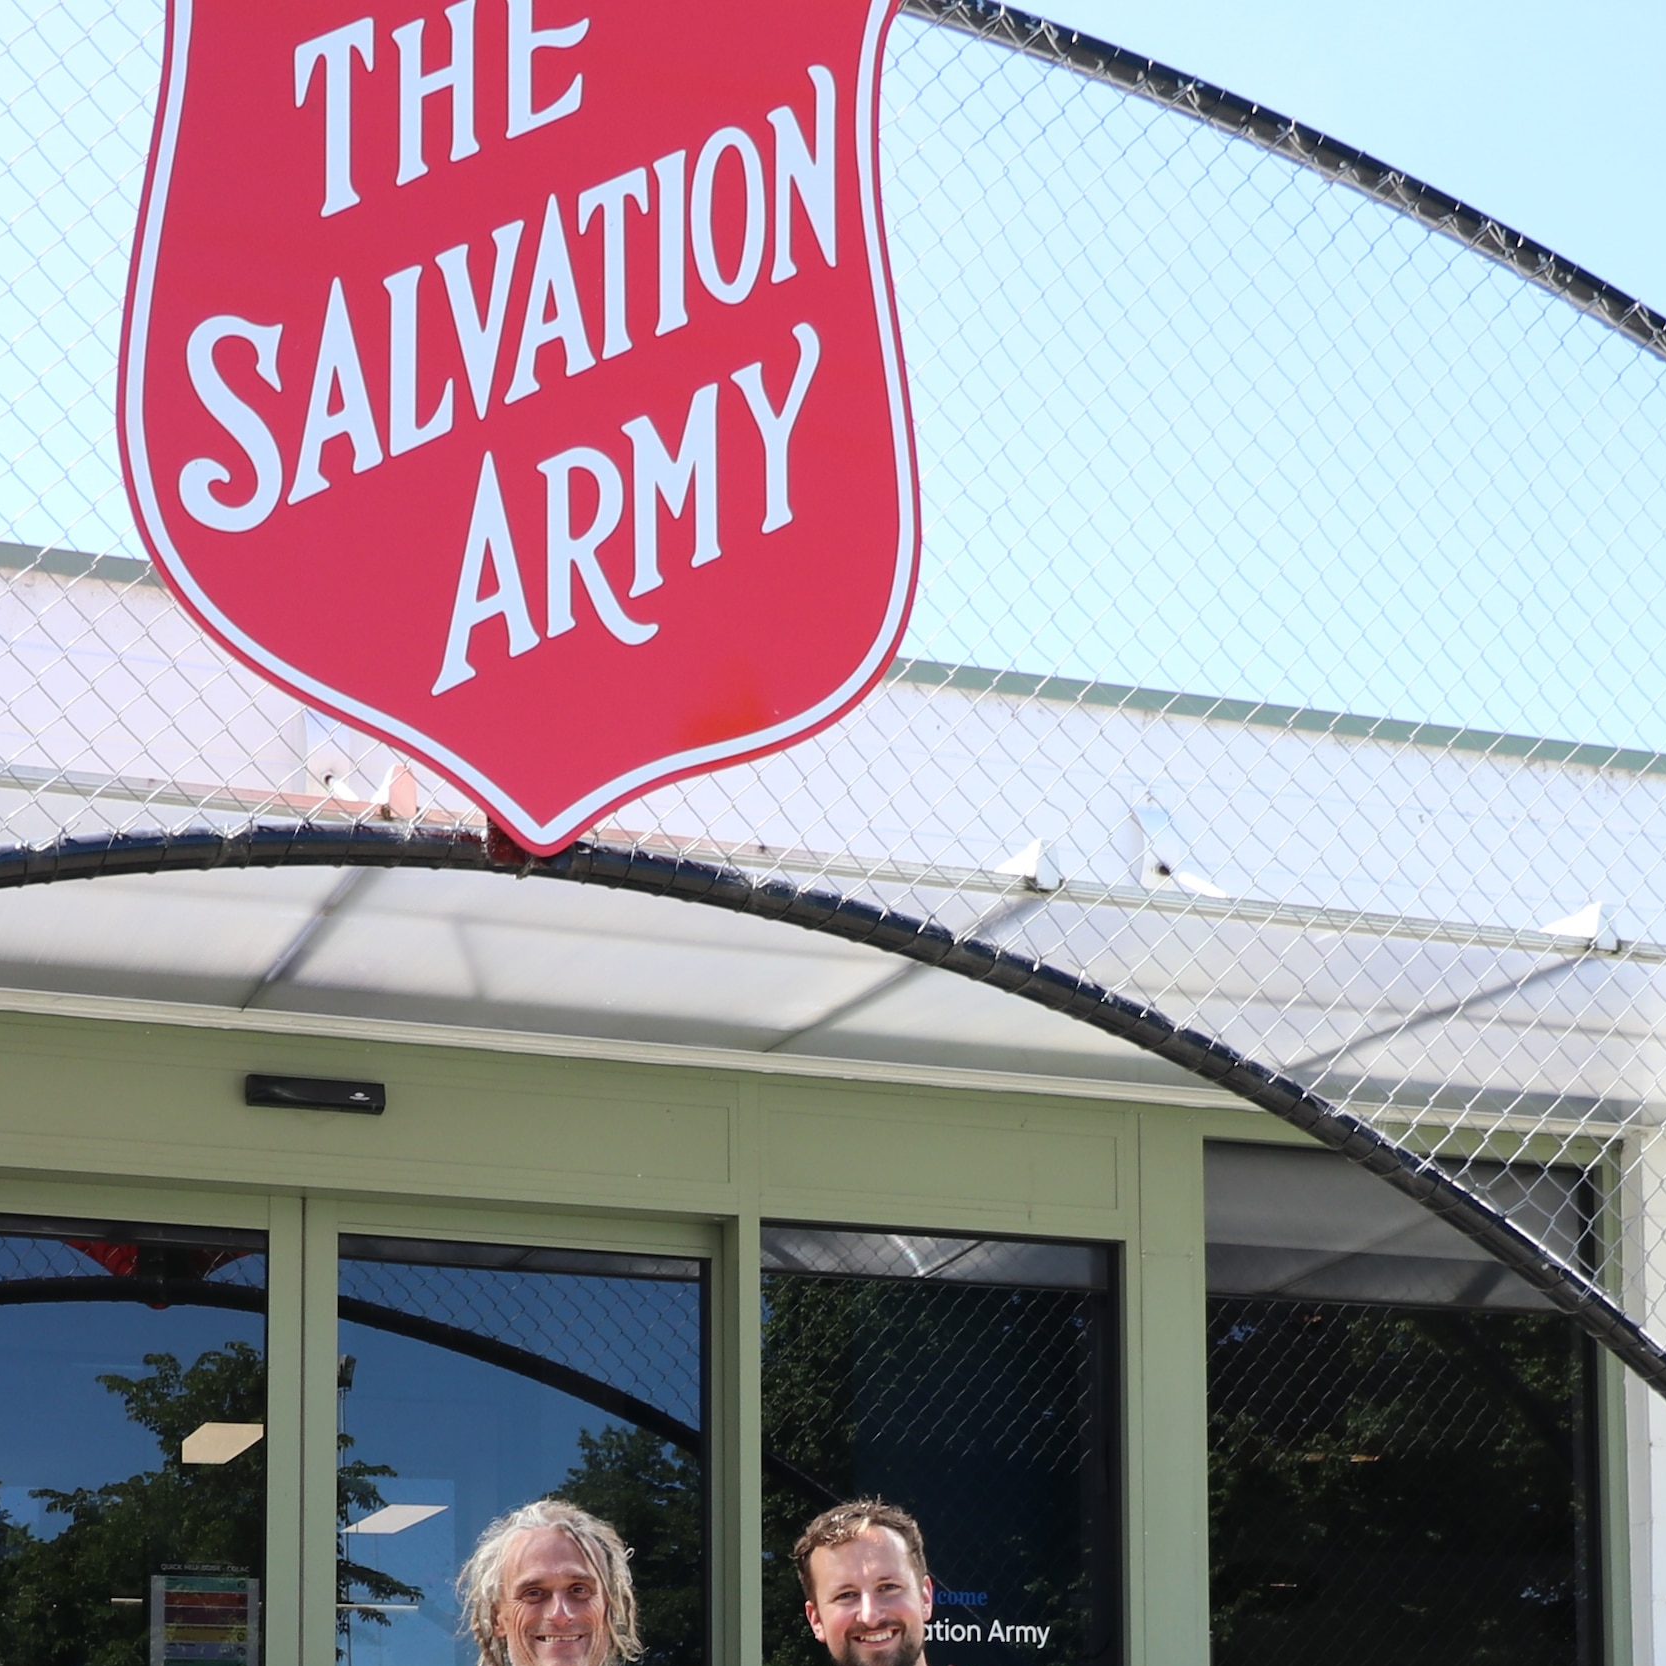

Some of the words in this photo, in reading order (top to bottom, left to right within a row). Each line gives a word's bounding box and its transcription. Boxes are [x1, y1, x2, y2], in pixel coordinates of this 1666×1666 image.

[294, 0, 590, 217] THE
[179, 64, 836, 532] SALVATION
[432, 323, 820, 696] ARMY
[924, 1618, 982, 1642] ation
[988, 1619, 1050, 1649] Army
